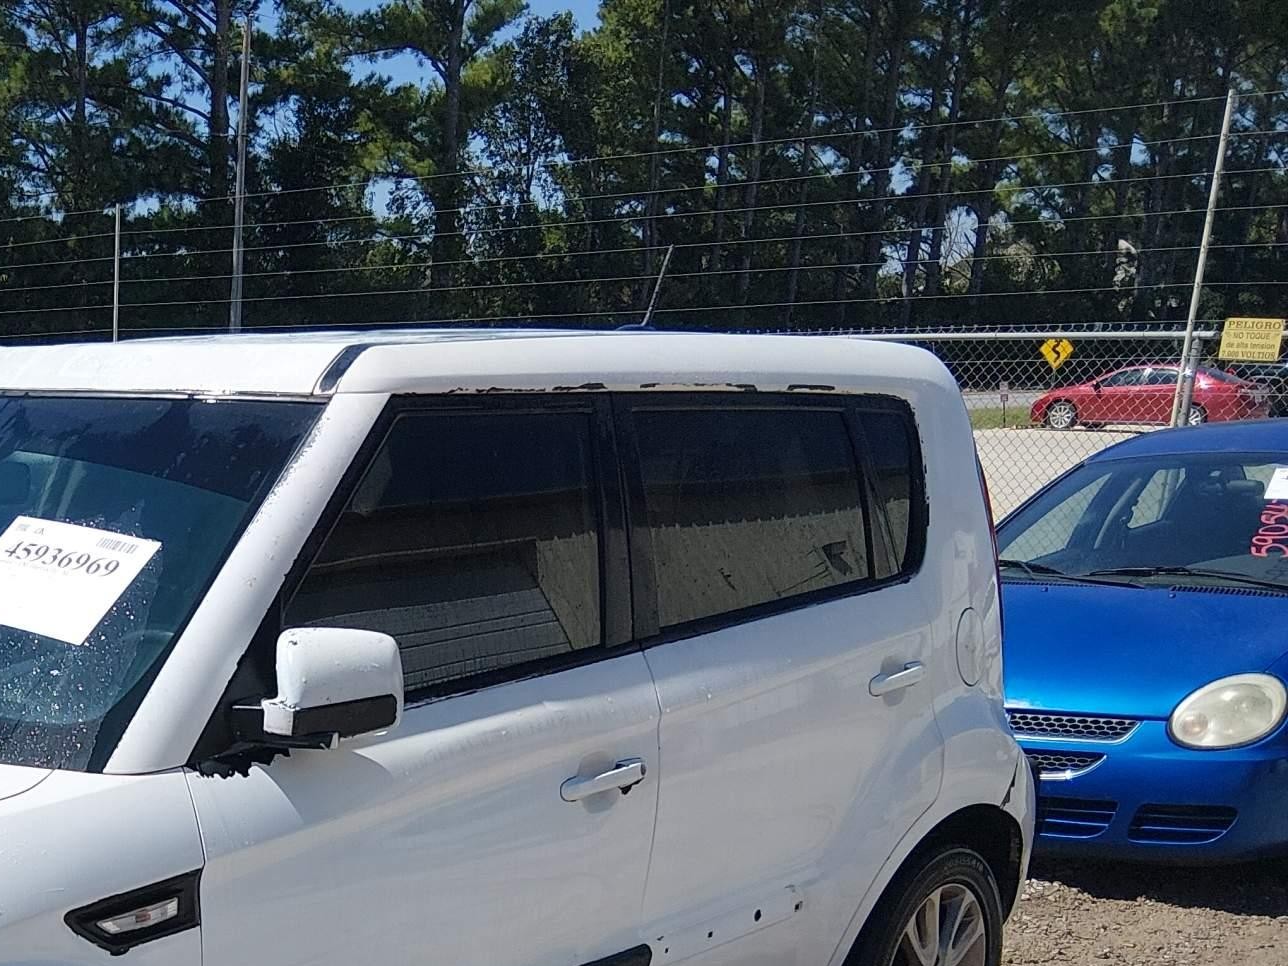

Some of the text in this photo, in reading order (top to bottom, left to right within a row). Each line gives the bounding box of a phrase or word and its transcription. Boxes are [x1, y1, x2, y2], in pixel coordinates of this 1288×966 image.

[1228, 320, 1282, 330] PELIGRO
[1233, 332, 1271, 340] NO TOQUE
[1241, 351, 1276, 360] VOLTIOS
[4, 540, 120, 577] 45936969
